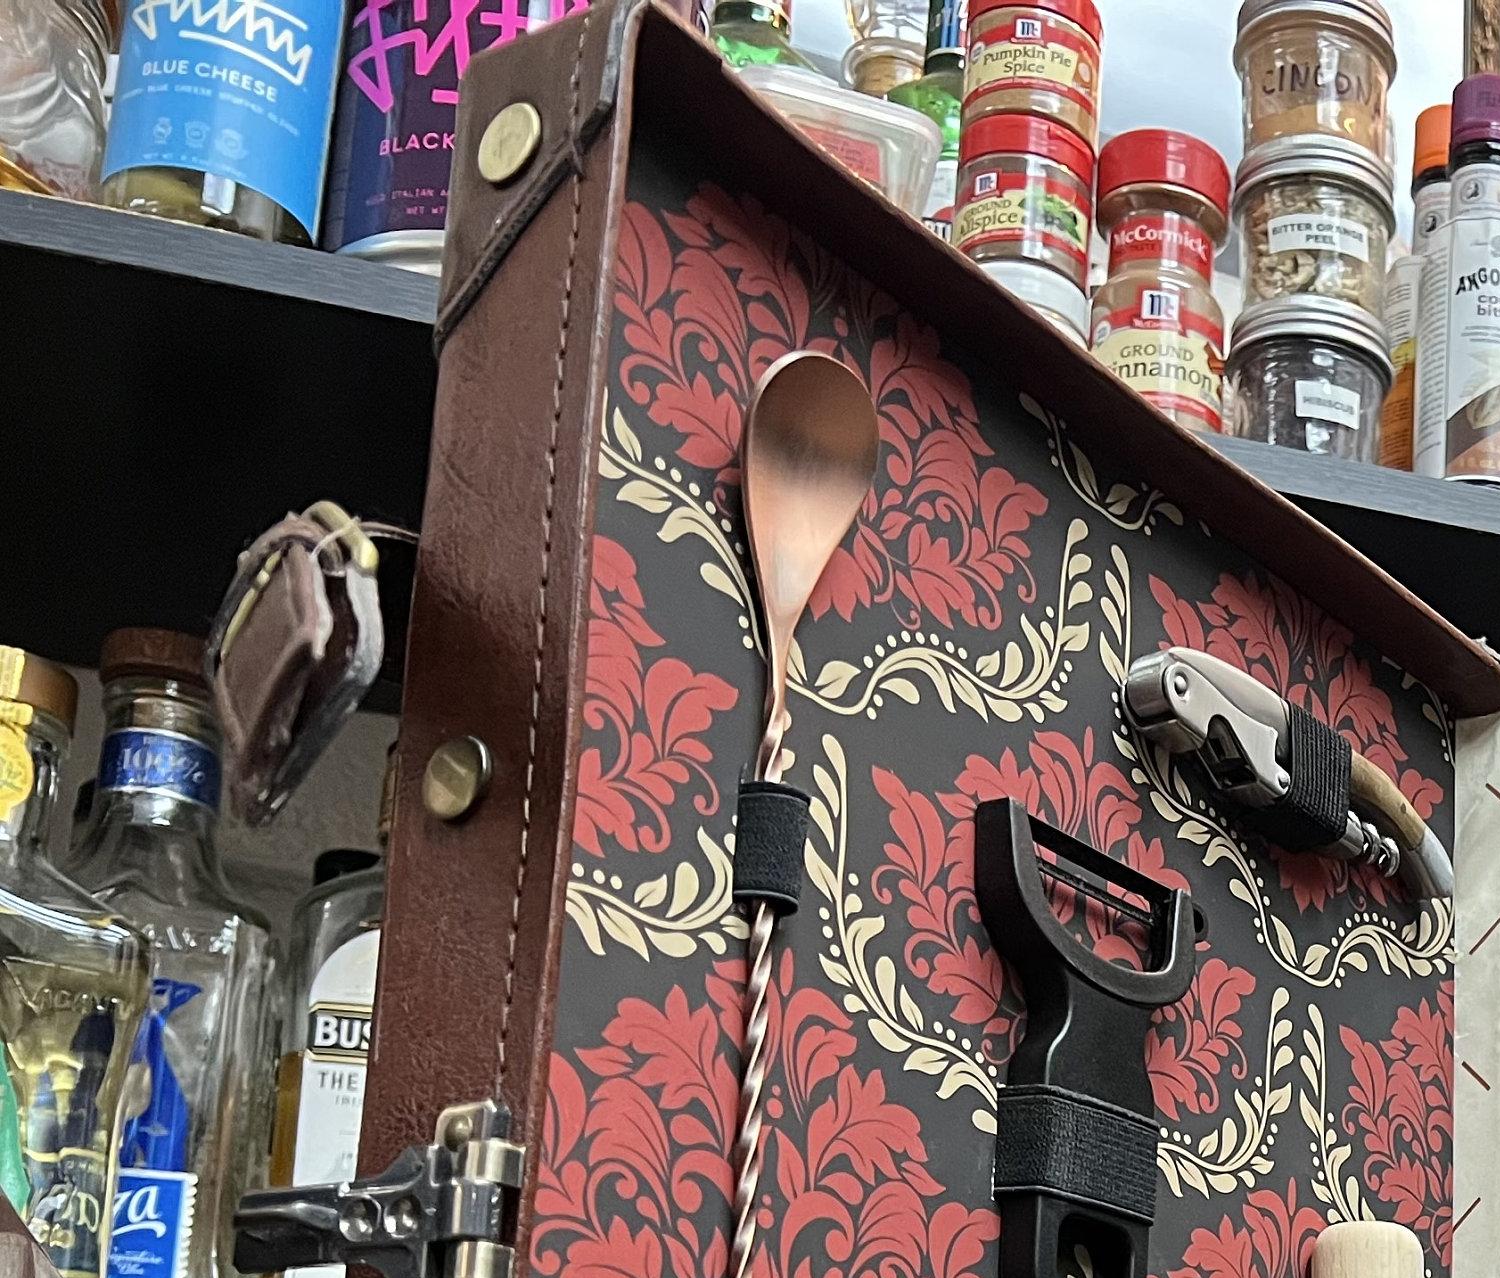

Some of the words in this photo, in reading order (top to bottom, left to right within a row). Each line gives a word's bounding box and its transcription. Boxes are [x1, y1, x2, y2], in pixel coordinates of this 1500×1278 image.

[983, 46, 1046, 66] Pumpkin
[1050, 50, 1072, 68] Pie
[1003, 61, 1045, 76] Spice
[142, 60, 189, 76] BLUE
[195, 62, 278, 102] CHEESE
[379, 132, 456, 156] BLACK
[963, 199, 1012, 220] GROUND
[960, 209, 1019, 237] Allspice
[1271, 222, 1312, 236] BITTER
[1315, 224, 1364, 243] ORANGE
[1114, 224, 1208, 262] McCormick
[1305, 233, 1336, 246] PEEL
[1120, 344, 1194, 362] GROUND
[1109, 361, 1213, 393] innamon
[318, 1071, 360, 1091] THE
